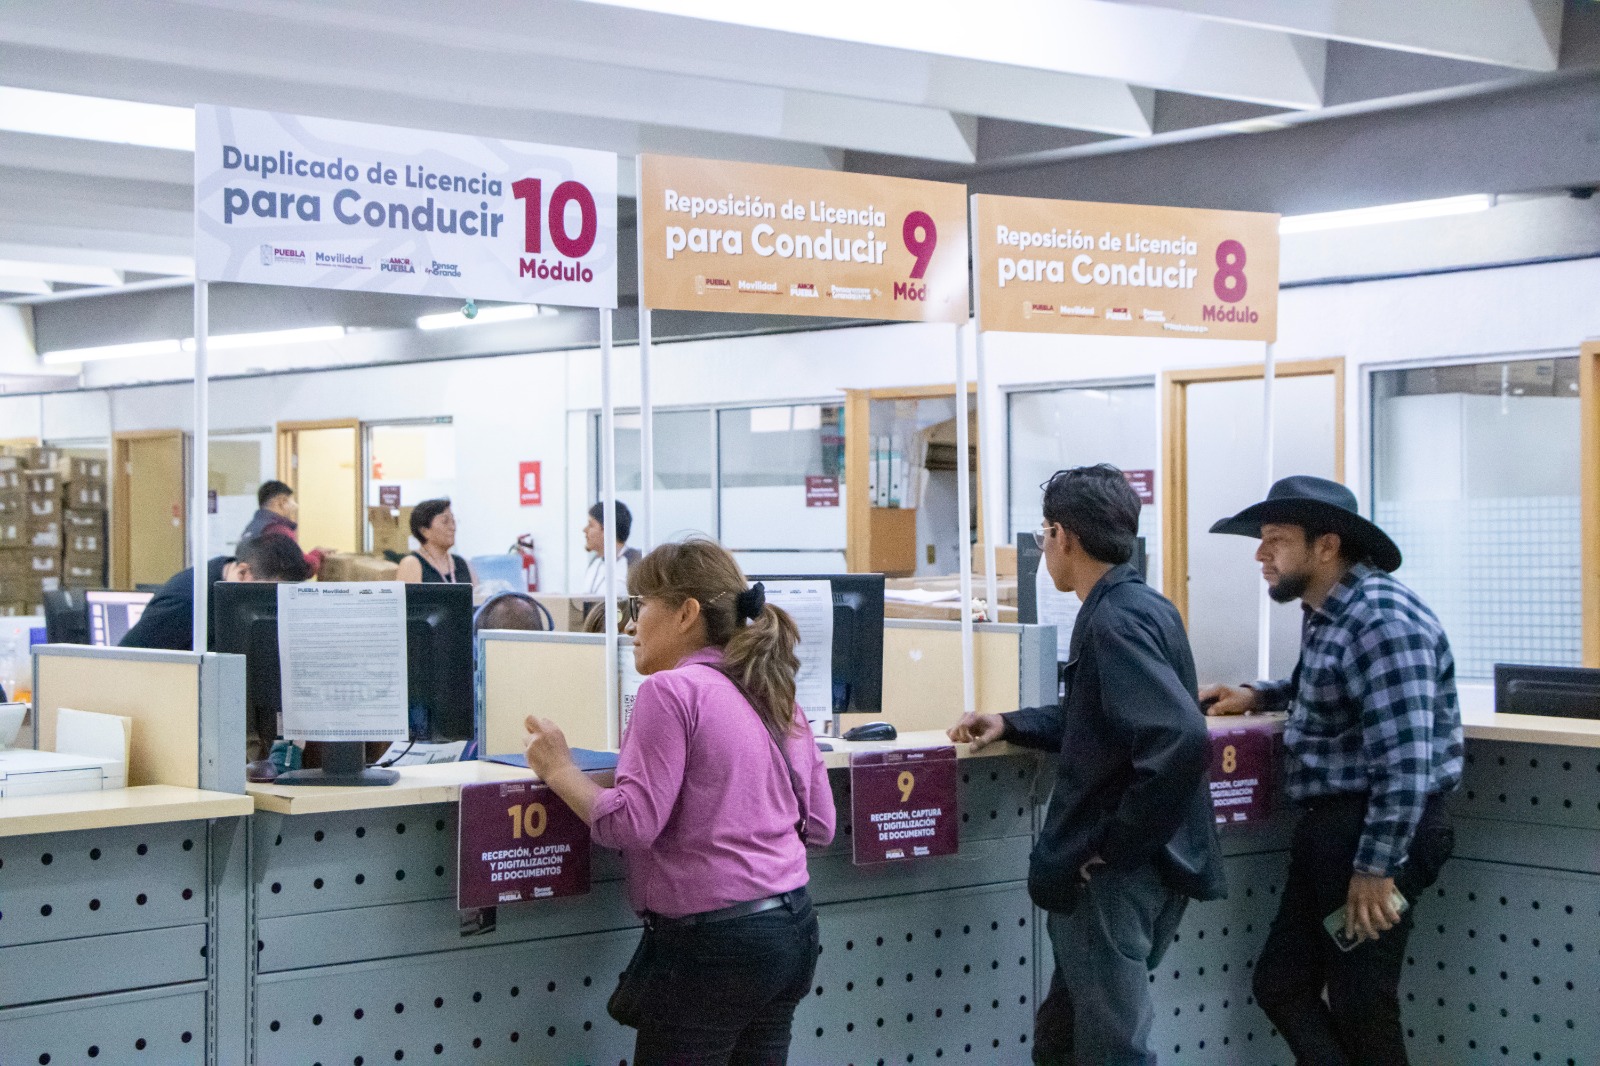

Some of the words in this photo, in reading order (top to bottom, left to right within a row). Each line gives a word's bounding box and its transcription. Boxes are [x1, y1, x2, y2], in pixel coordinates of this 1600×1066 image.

[222, 145, 360, 184] Duplicado
[366, 160, 398, 187] de
[405, 164, 502, 197] Licencia
[223, 186, 321, 224] para
[333, 188, 504, 238] Conducir
[511, 177, 598, 258] 10
[664, 188, 776, 220] Reposición
[780, 198, 806, 220] de
[810, 200, 887, 229] Licencia
[665, 224, 743, 260] para
[751, 223, 888, 265] Conducir
[902, 210, 938, 280] 9
[996, 225, 1095, 251] Reposición
[1098, 232, 1122, 252] de
[1126, 233, 1198, 256] Licencia
[274, 248, 306, 259] PUEBLA
[315, 251, 364, 265] Movilidad
[431, 259, 459, 270] Pensar
[380, 263, 416, 273] PUEBLA
[432, 266, 462, 278] Grande
[519, 257, 594, 283] Módulo
[997, 255, 1065, 288] para
[1071, 254, 1198, 289] Conducir
[1213, 239, 1248, 304] 8
[705, 278, 731, 287] PUEBLA
[738, 279, 778, 291] Movilidad
[1202, 303, 1259, 325] Módulo
[1222, 744, 1237, 774] 8
[897, 770, 915, 803] 9
[507, 802, 548, 840] 10
[870, 810, 910, 823] RECEPCIÓN,
[911, 808, 942, 818] CAPTURA
[877, 823, 883, 831] Y
[883, 818, 936, 831] DIGITALIZACIÓN
[878, 833, 889, 842] DE
[889, 828, 936, 840] DOCUMENTOS
[481, 847, 532, 861] RECEPCIÓN,
[533, 844, 571, 856] CAPTURA
[490, 862, 497, 871] Y
[497, 855, 563, 871] DIGITALIZACIÓN
[491, 871, 503, 882] DE
[504, 866, 562, 880] DOCUMENTOS
